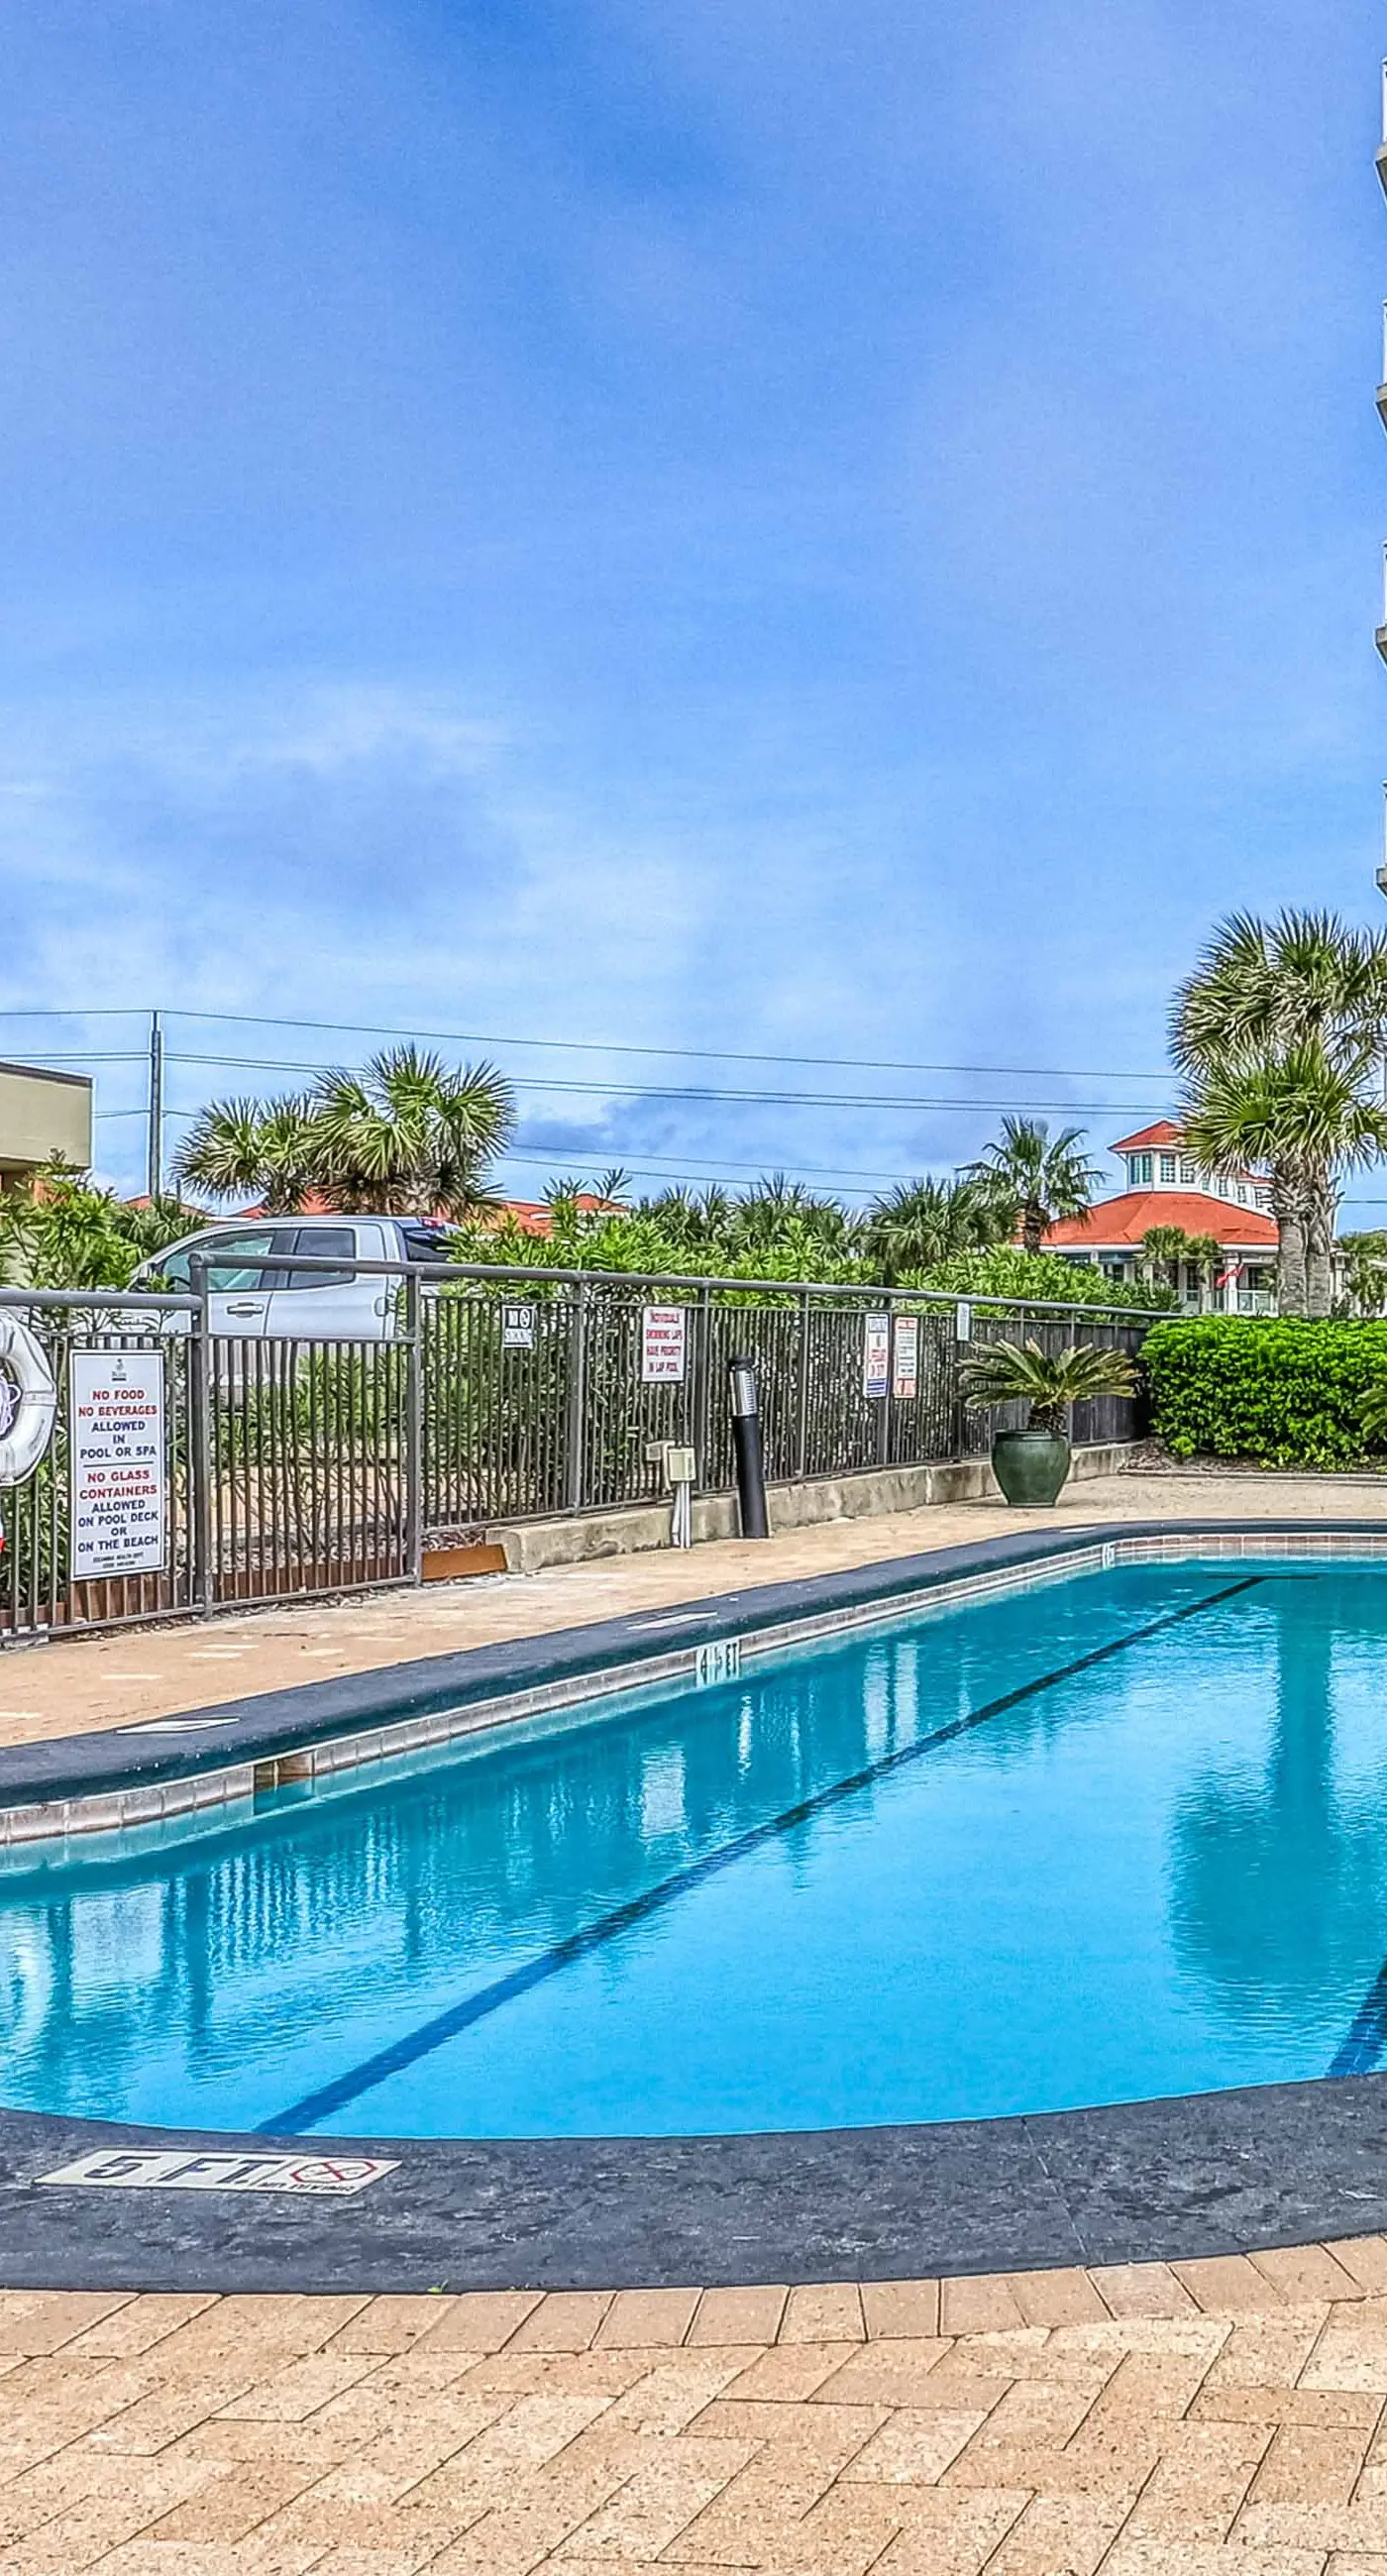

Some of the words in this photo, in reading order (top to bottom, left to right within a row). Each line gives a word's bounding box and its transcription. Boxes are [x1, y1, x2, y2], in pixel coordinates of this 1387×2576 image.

[92, 1390, 110, 1400] NO
[114, 1389, 145, 1399] FOOD
[78, 1407, 94, 1417] NO
[98, 1405, 158, 1416] BEVERAGES
[91, 1421, 146, 1433] ALLOWED
[113, 1435, 125, 1444] IN
[80, 1449, 111, 1458] POOL
[115, 1447, 132, 1456] OR
[136, 1446, 158, 1456] SPA
[87, 1473, 105, 1483] NO
[111, 1470, 150, 1481] GLASS
[79, 1485, 158, 1499] CONTAINERS
[91, 1499, 146, 1513] ALLOWED
[78, 1517, 93, 1527] ON
[98, 1515, 127, 1526] POOL
[131, 1511, 159, 1522] DECK
[111, 1527, 127, 1536] OR
[78, 1542, 94, 1553] ON
[98, 1540, 119, 1551] THE
[124, 1536, 159, 1548] BEACH
[83, 2155, 161, 2179] 5
